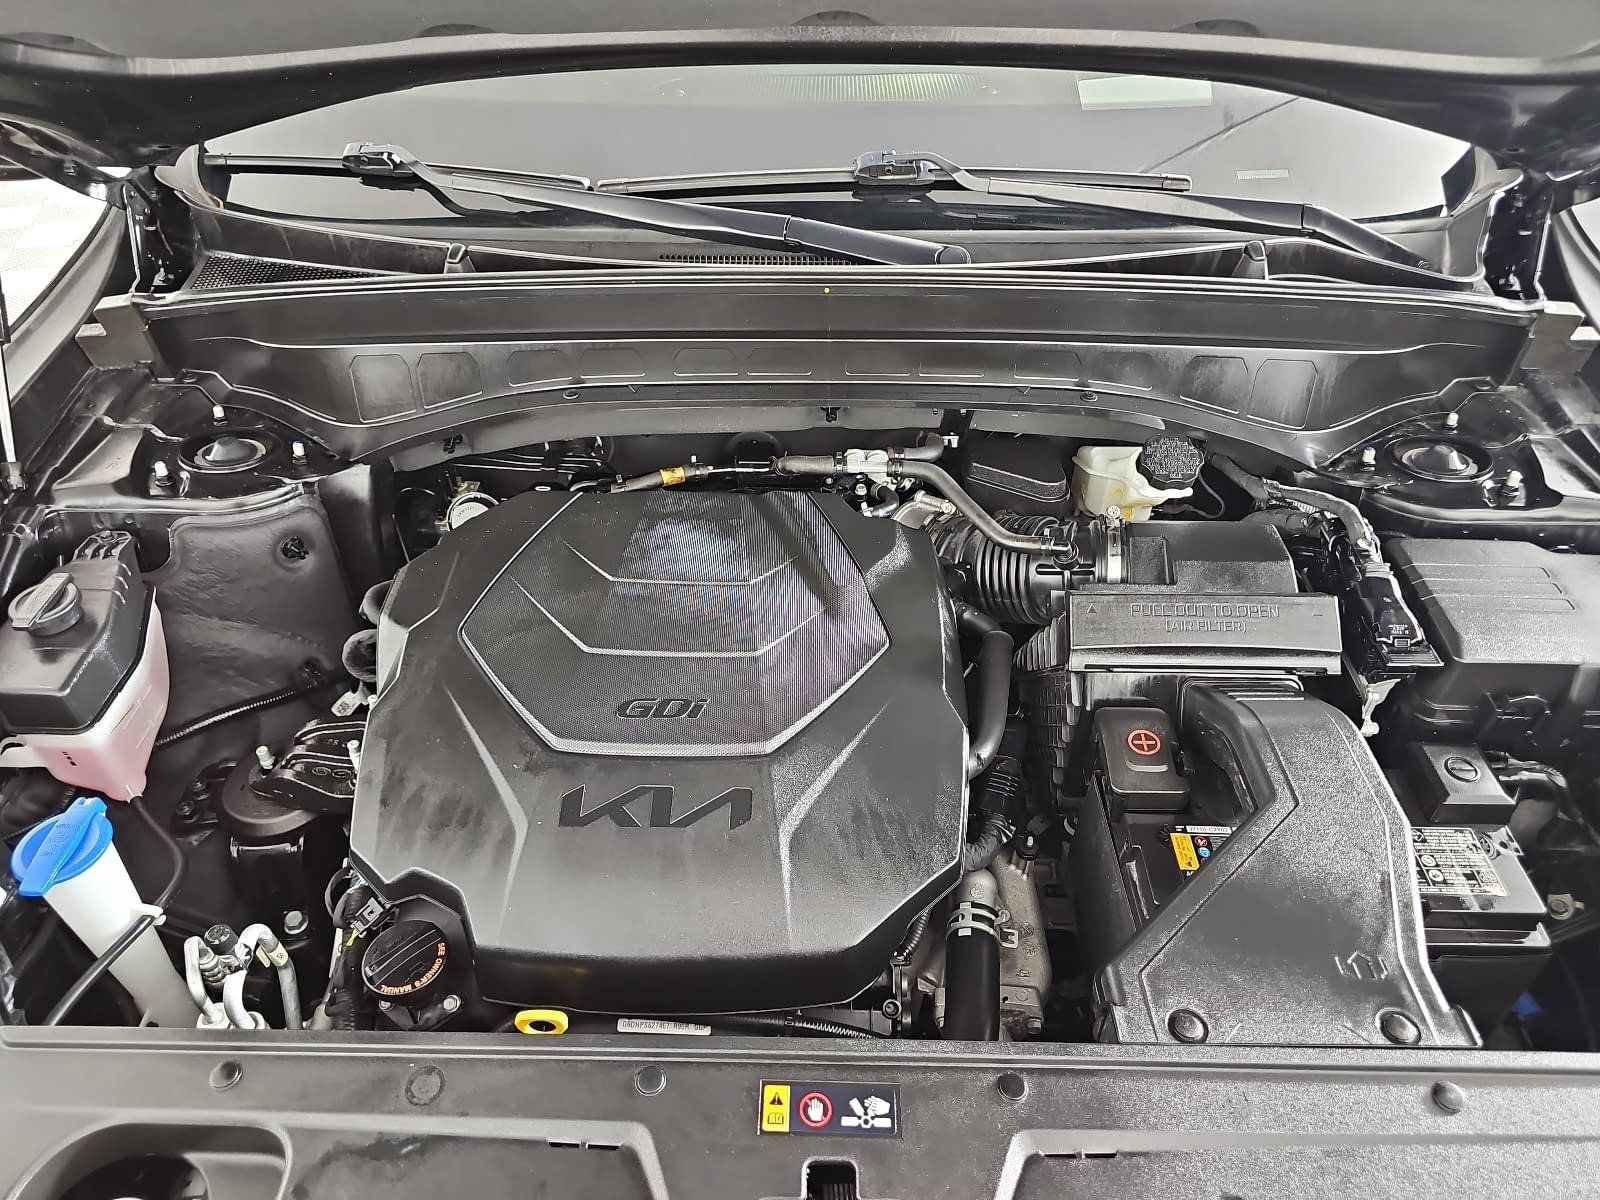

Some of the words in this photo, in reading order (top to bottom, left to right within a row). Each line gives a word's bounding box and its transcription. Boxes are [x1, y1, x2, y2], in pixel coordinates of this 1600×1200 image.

[1130, 603, 1172, 617] PULL
[1174, 603, 1206, 617] OUT
[1210, 603, 1232, 617] TO
[1236, 603, 1279, 618] OPEN
[1165, 618, 1193, 633] (AIR
[1197, 618, 1247, 633] FILTER)
[559, 784, 753, 830] KIA
[437, 942, 446, 956] SEE
[414, 958, 443, 987] OWNER'S
[380, 984, 412, 994] MANUAL
